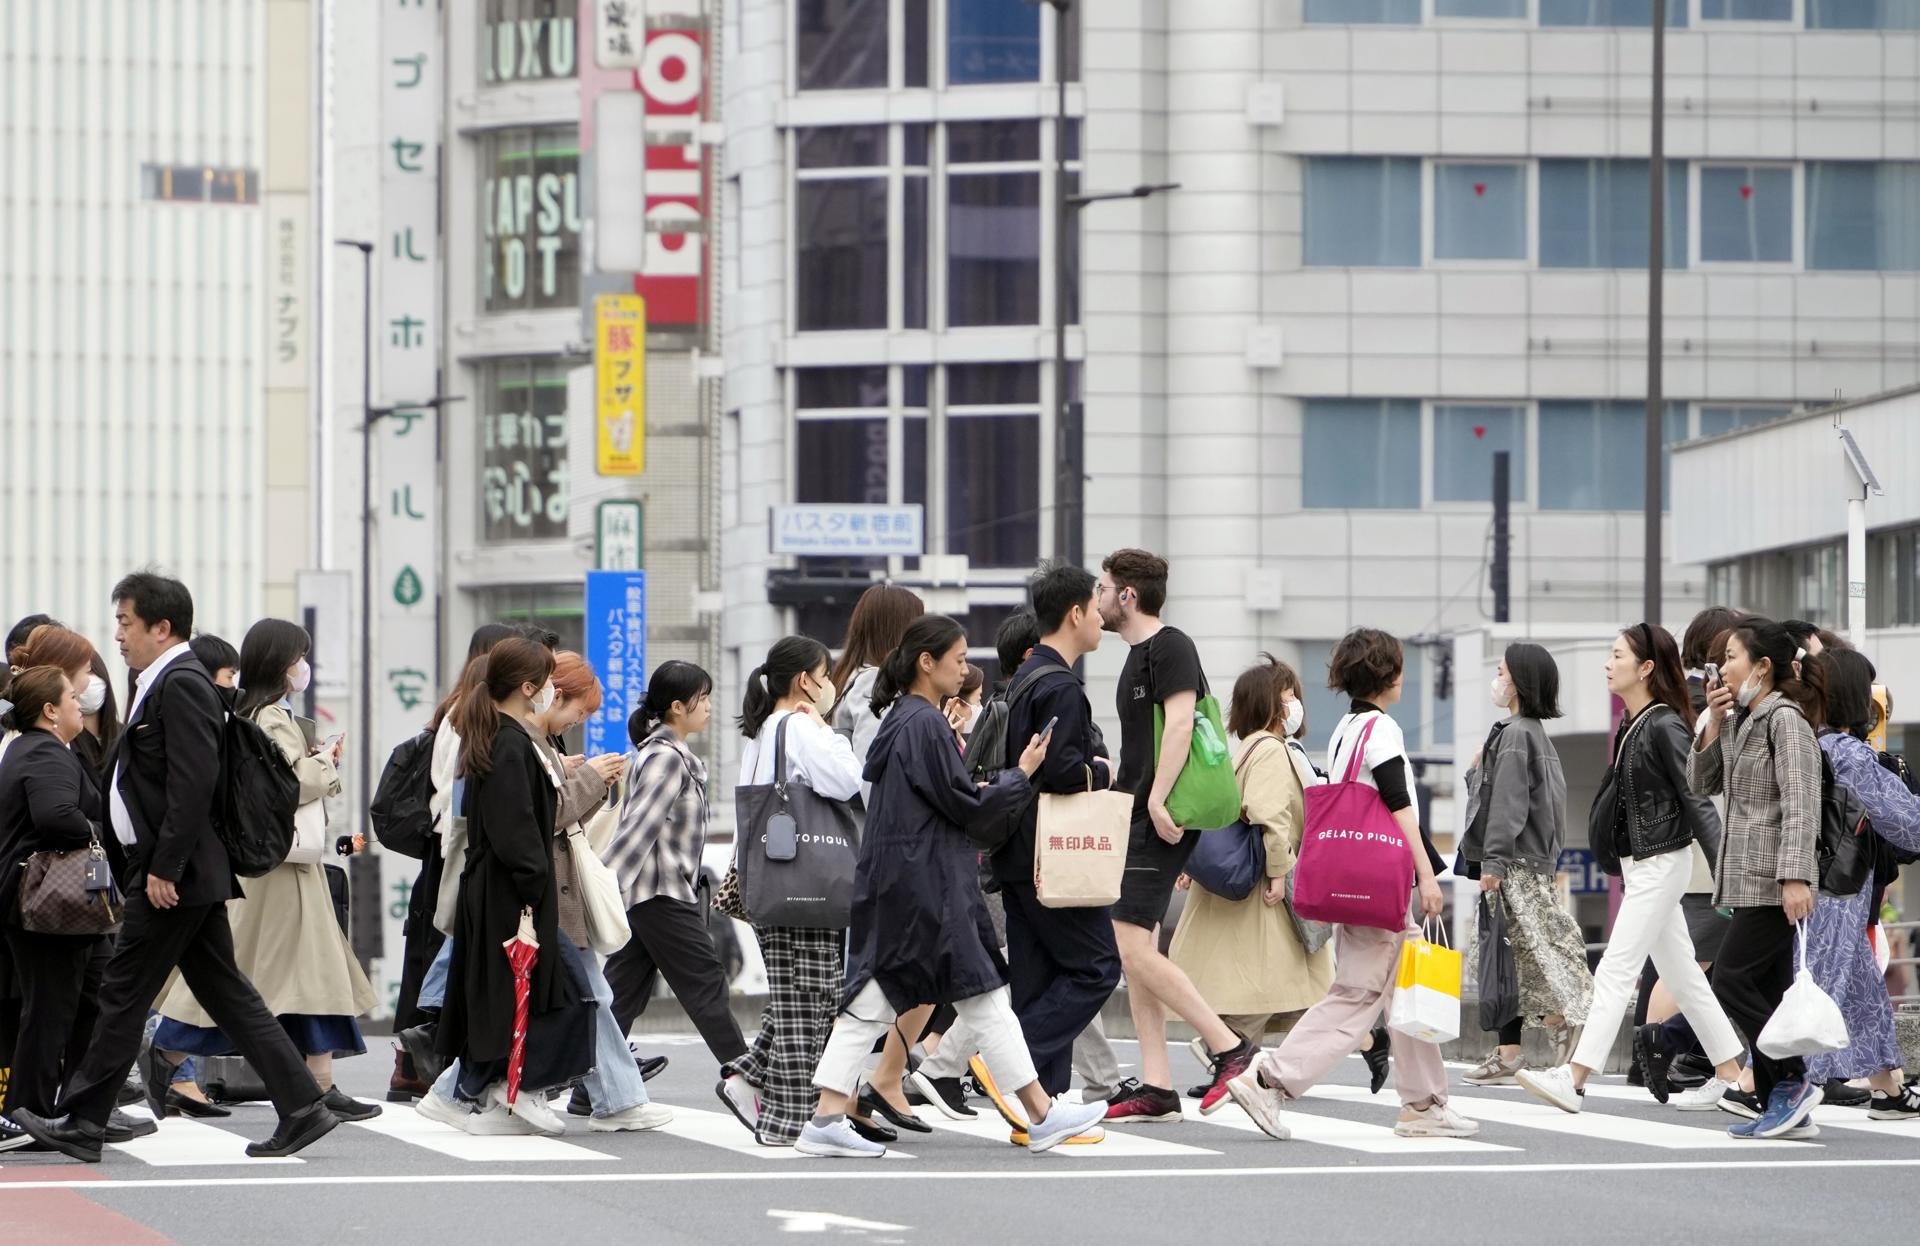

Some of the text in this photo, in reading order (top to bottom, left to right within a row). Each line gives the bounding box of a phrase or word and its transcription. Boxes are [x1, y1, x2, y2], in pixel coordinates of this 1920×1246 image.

[391, 0, 428, 522] プセルホテル
[761, 833, 810, 843] GTO
[1049, 835, 1112, 851] 無印良品
[1318, 829, 1403, 847] GELATO PIQUE
